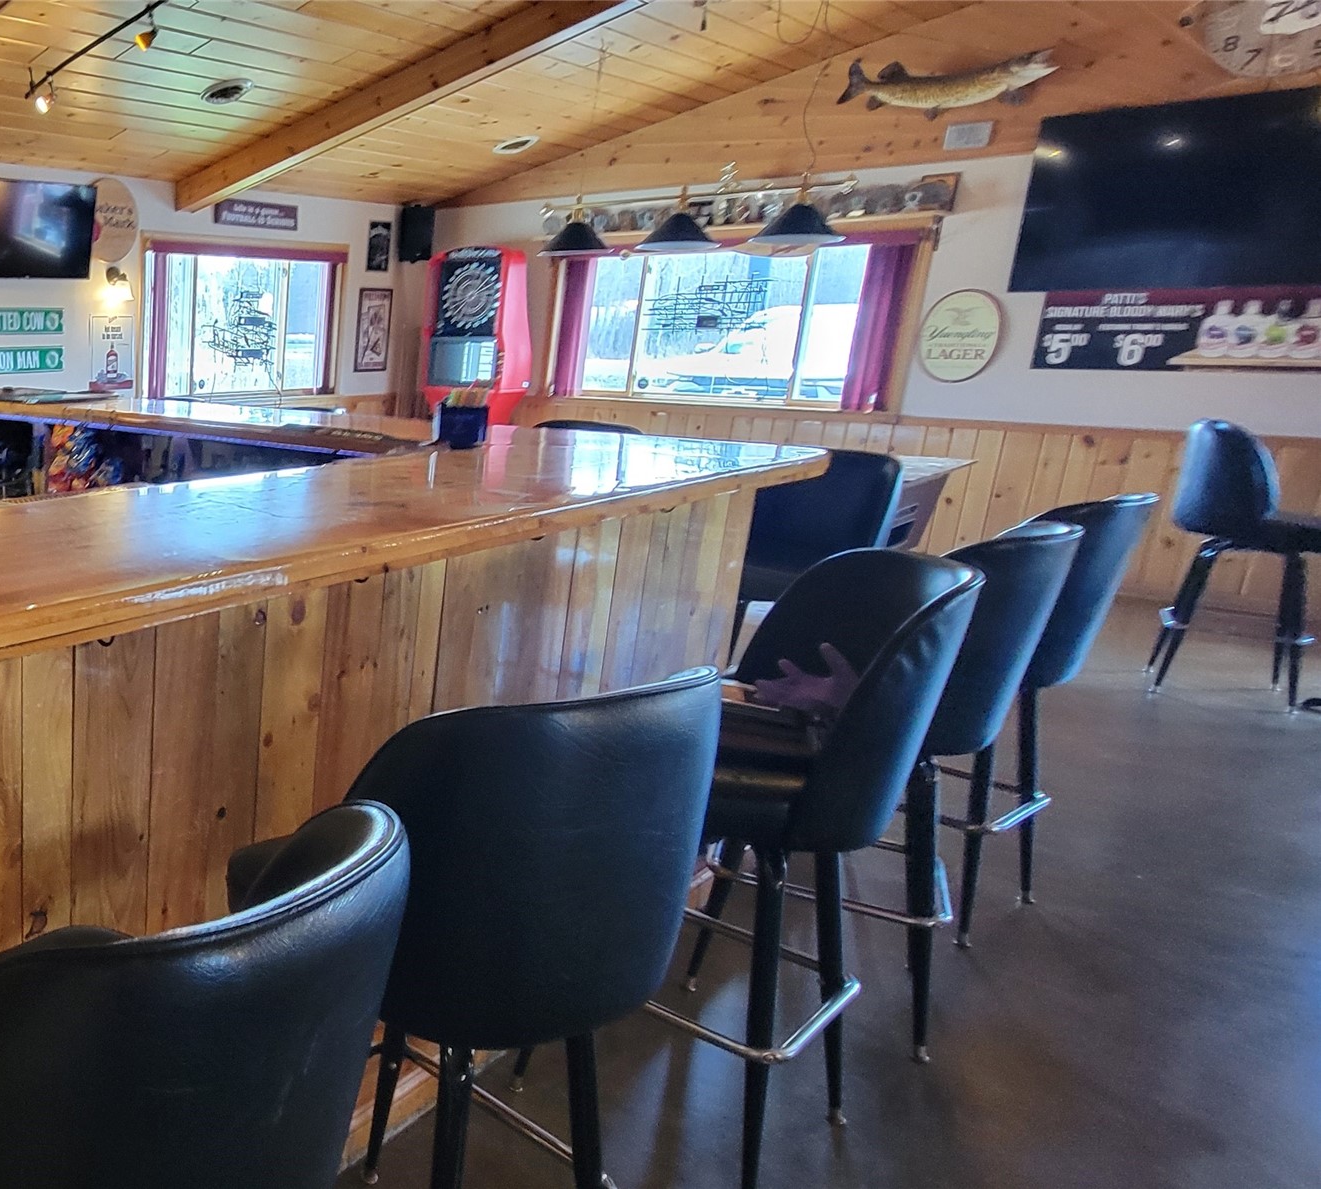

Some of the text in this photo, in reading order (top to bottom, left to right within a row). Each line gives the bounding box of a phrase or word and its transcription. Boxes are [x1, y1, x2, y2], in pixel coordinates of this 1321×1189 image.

[1045, 305, 1107, 318] SIGNATURE
[22, 311, 45, 331] COW
[17, 350, 41, 370] MAN
[925, 348, 986, 360] LAGER
